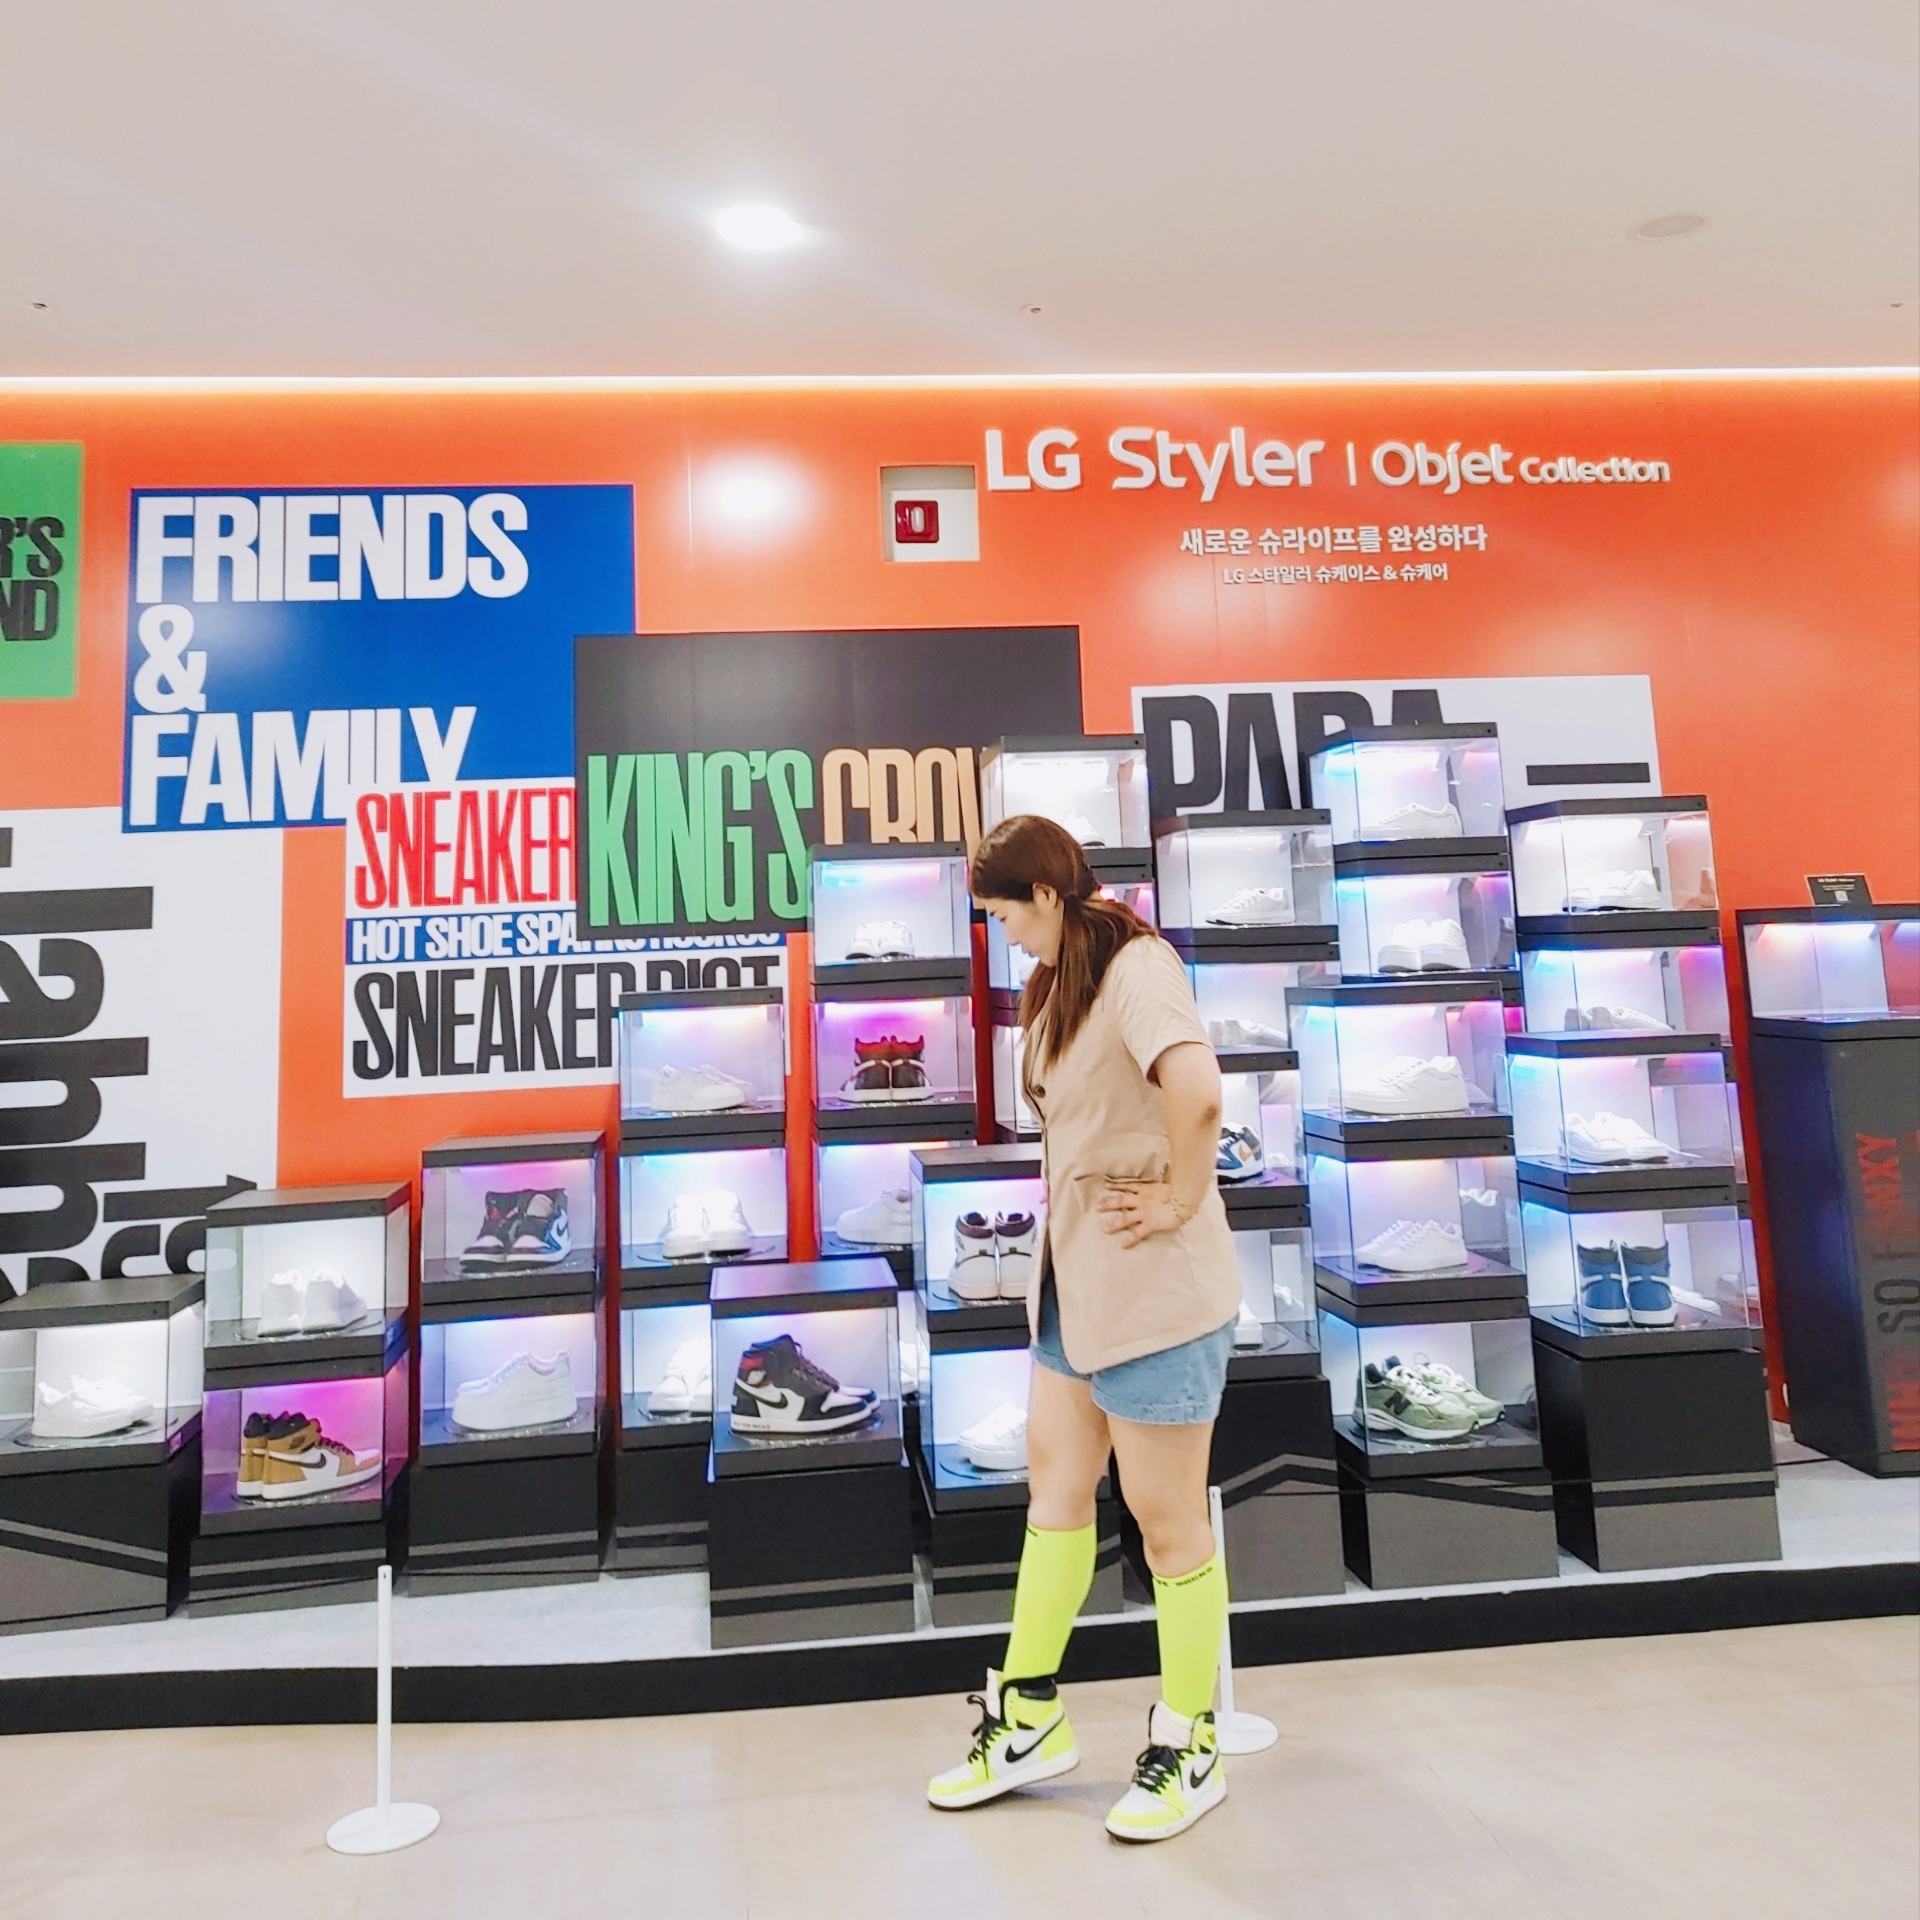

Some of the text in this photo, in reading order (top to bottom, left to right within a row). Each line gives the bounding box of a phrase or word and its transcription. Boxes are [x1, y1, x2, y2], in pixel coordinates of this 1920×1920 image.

[985, 428, 1082, 491] LG
[1108, 426, 1326, 503] Styler
[1372, 441, 1515, 495] Objet
[1519, 456, 1671, 484] Collection
[136, 493, 529, 604] FRIENDS
[1179, 523, 1489, 556] 새로운 슈라이프를 완성하다
[1222, 562, 1450, 584] LG 스타일러 슈케이스 & 슈케어
[133, 604, 207, 713] &
[130, 706, 478, 827] FAMILY
[355, 788, 578, 910] SNEAKER
[587, 749, 815, 927] KING'S
[352, 918, 422, 962] HOT
[425, 914, 513, 959] SHOE
